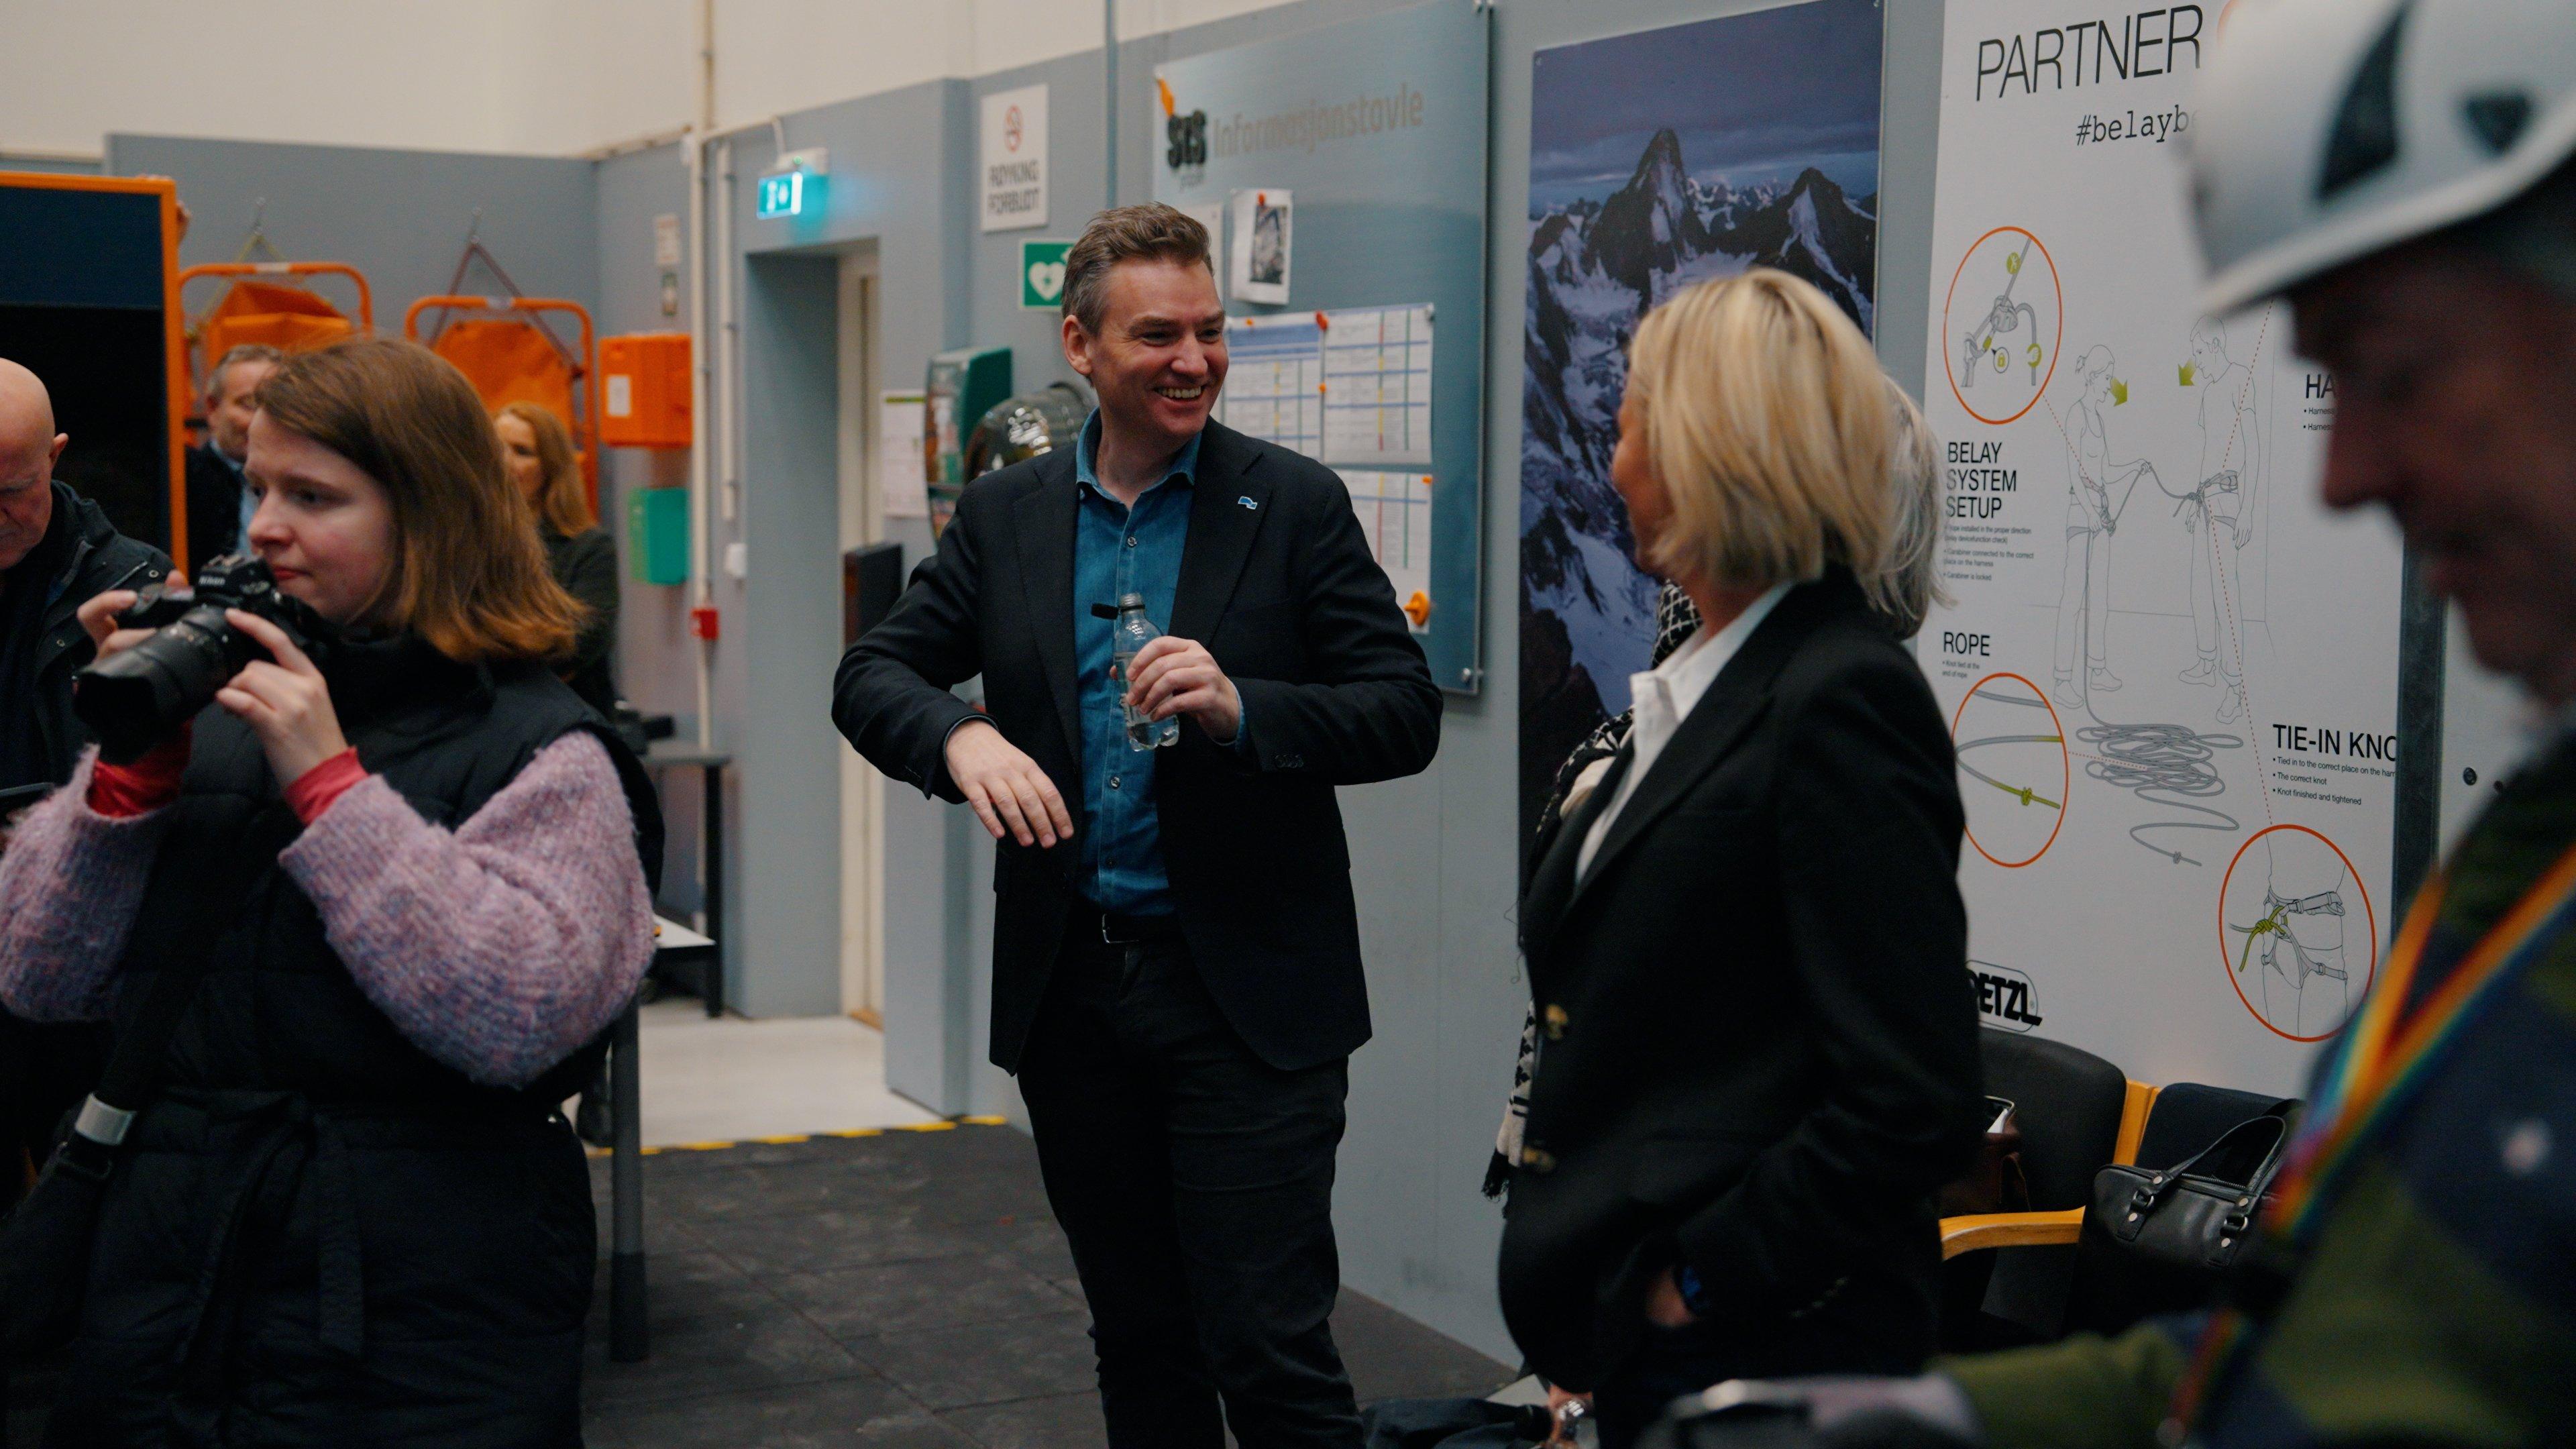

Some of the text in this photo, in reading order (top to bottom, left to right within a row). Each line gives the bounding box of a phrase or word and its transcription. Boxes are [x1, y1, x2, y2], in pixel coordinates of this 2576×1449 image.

[1976, 4, 2203, 102] PARTNER
[988, 188, 1040, 215] FORBUDT
[1948, 441, 2002, 464] BELAY
[1946, 469, 2017, 492] SYSTEM
[1946, 496, 2002, 519] SETUP
[1944, 632, 1990, 656] ROPE
[2273, 724, 2341, 755] TIE-IN
[2277, 757, 2290, 765] Tied
[2299, 759, 2306, 767] to
[2306, 759, 2317, 769] the
[2318, 763, 2341, 771] correct
[2341, 764, 2359, 774] place
[2360, 767, 2369, 775] on
[2370, 767, 2381, 776] the
[2277, 772, 2327, 786] The correct knot
[2277, 788, 2362, 806] Knot finished and tightened
